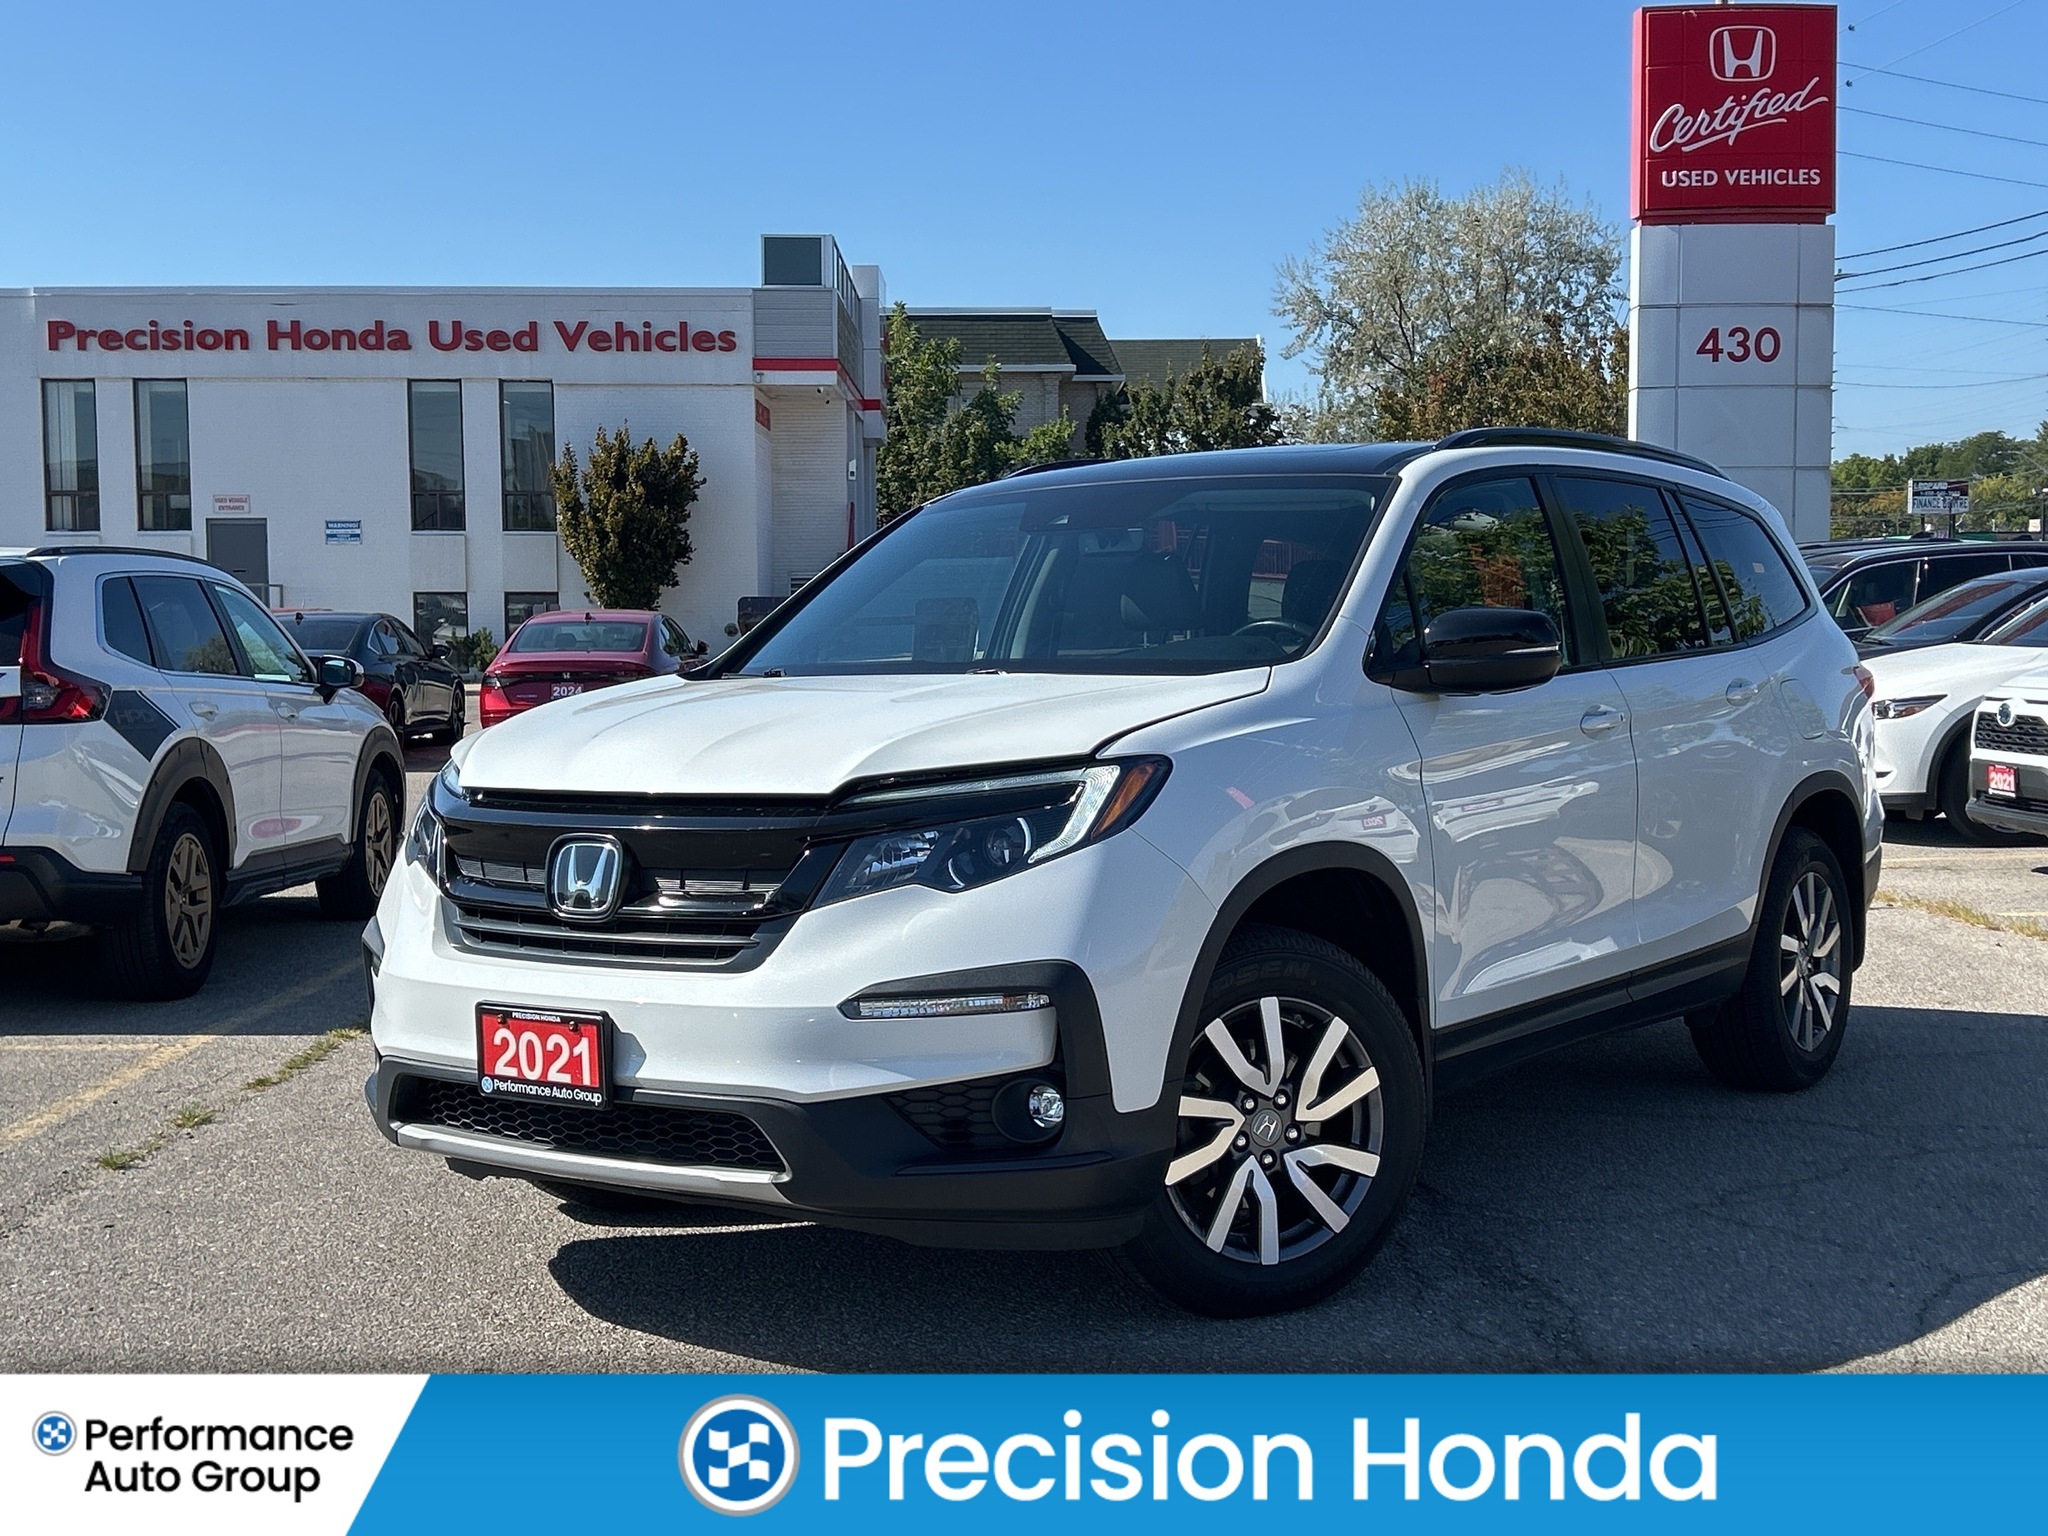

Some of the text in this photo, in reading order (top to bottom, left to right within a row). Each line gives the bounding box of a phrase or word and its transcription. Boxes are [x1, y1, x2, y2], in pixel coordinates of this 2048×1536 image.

[1650, 76, 1829, 153] Certified
[1661, 168, 1821, 188] USED VEHICLES
[47, 319, 738, 353] Precision Honda Used Vehicles
[1696, 326, 1782, 363] 430
[1990, 771, 2015, 791] 2021
[512, 1011, 562, 1022] PRECISION HONDA
[493, 1027, 592, 1087] 2021
[493, 1078, 602, 1106] Performance Auto Group
